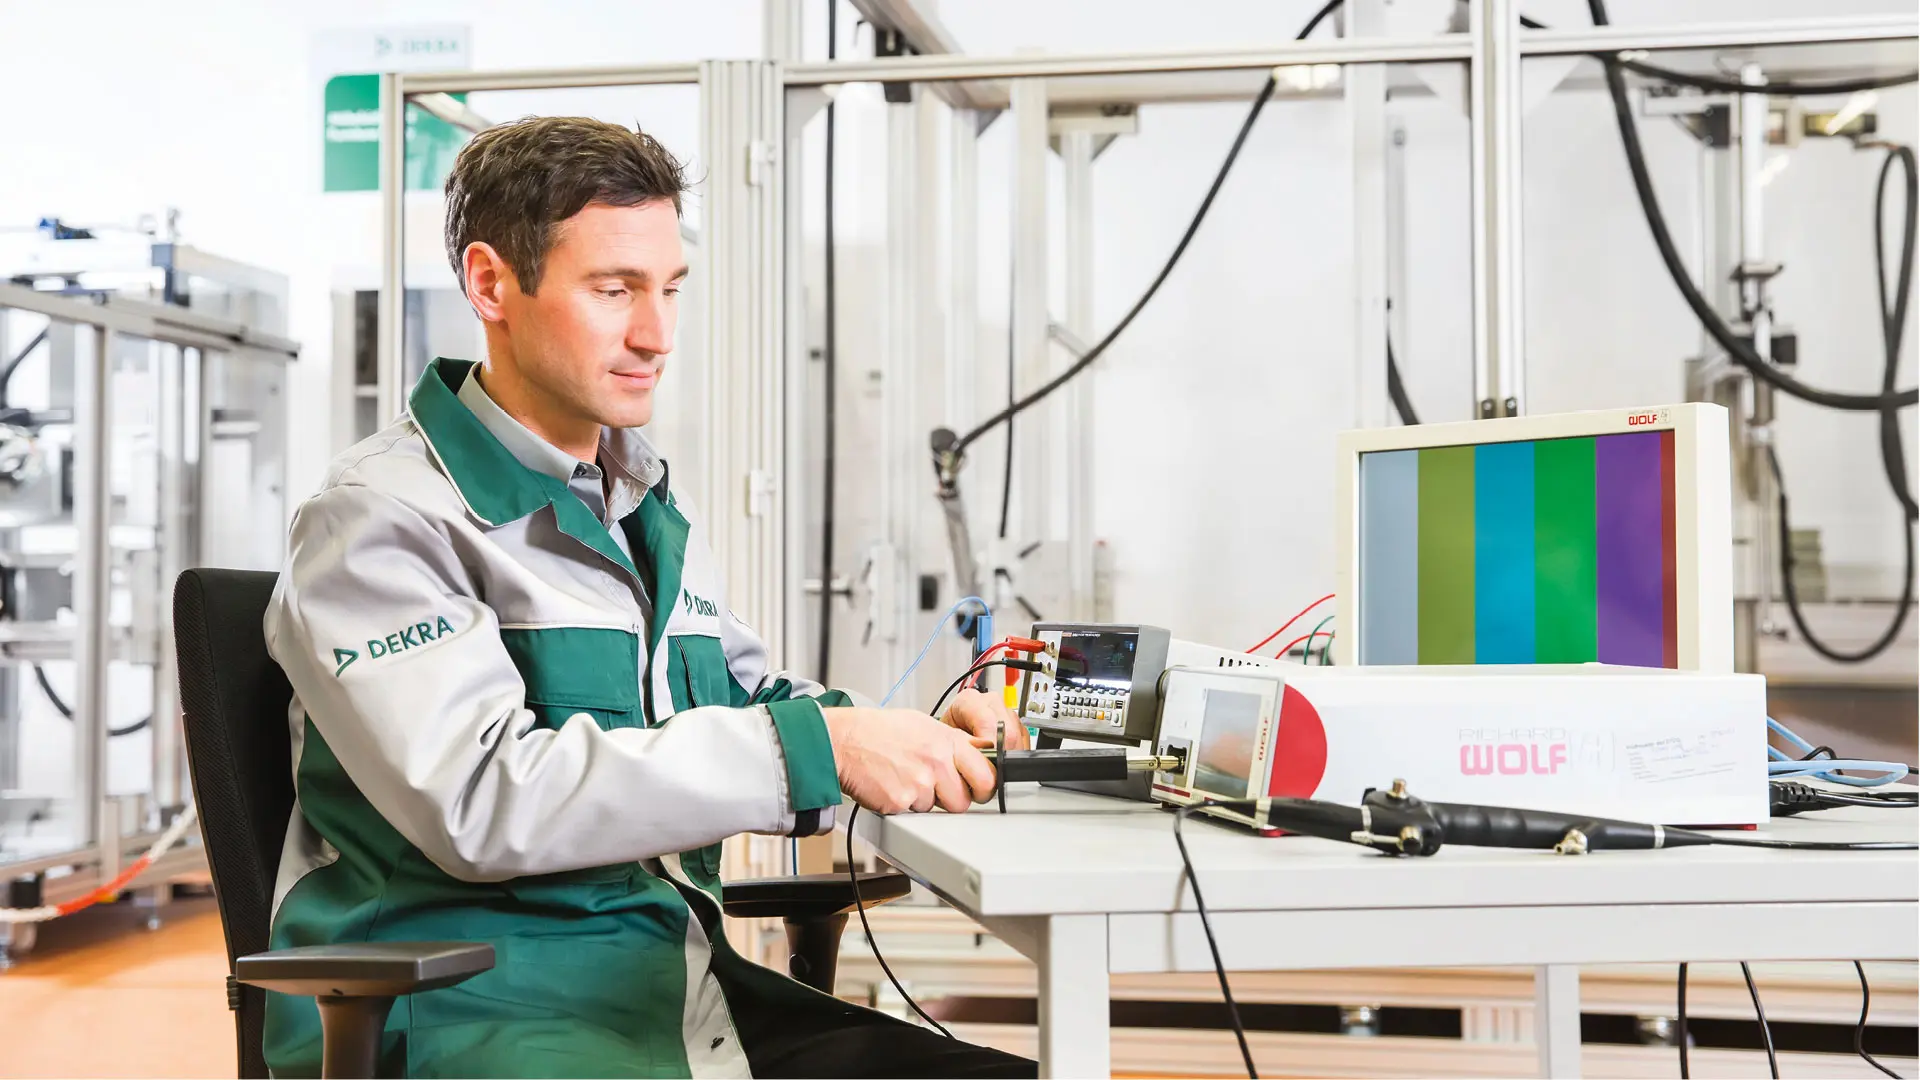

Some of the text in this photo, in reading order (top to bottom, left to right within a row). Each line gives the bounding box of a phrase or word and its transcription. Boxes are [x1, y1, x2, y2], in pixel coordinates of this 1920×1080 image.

[1628, 414, 1658, 426] WOLF
[367, 615, 456, 659] DEKRA
[1458, 727, 1567, 741] RICHARD
[1460, 743, 1567, 776] WOLF
